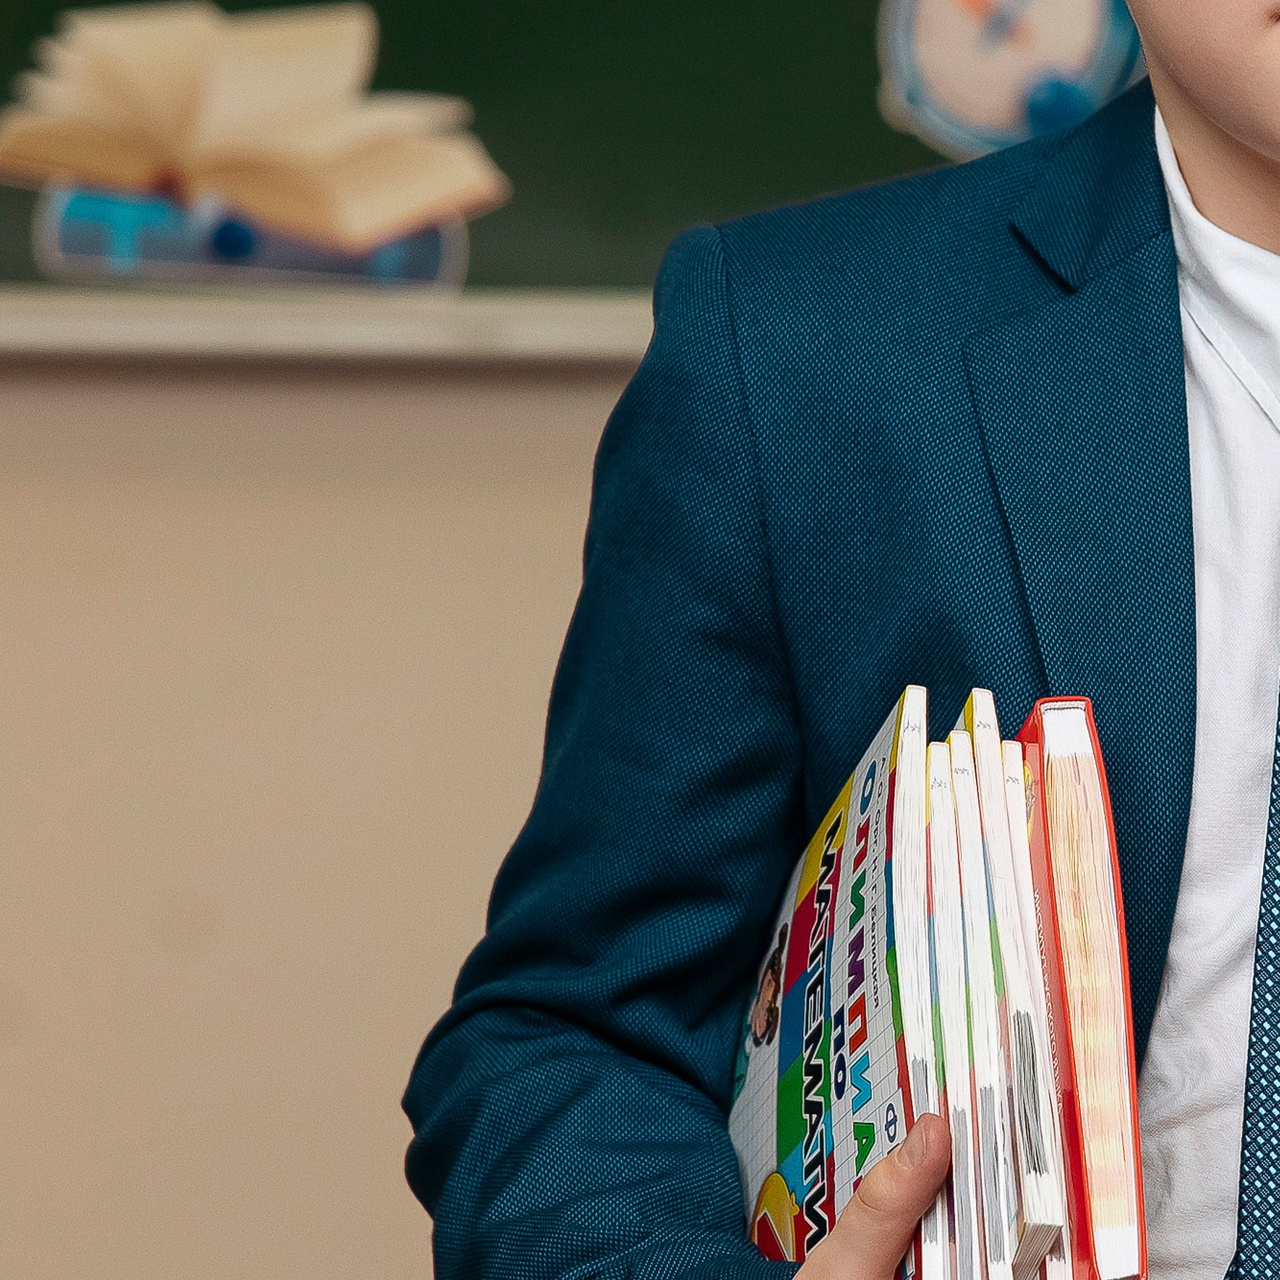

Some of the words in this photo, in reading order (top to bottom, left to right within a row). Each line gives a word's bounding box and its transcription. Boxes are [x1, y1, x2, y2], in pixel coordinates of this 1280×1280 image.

[803, 810, 844, 1254] МАТЕМАТИ
[830, 1004, 847, 1102] ПО
[848, 759, 878, 1190] ОЛИМПИА
[870, 904, 879, 1009] Белицкая
[1034, 888, 1047, 969] ИНСТИТУТ
[1043, 973, 1057, 1052] РУССКОГО
[1052, 1055, 1064, 1115] ЯЗЫКА
